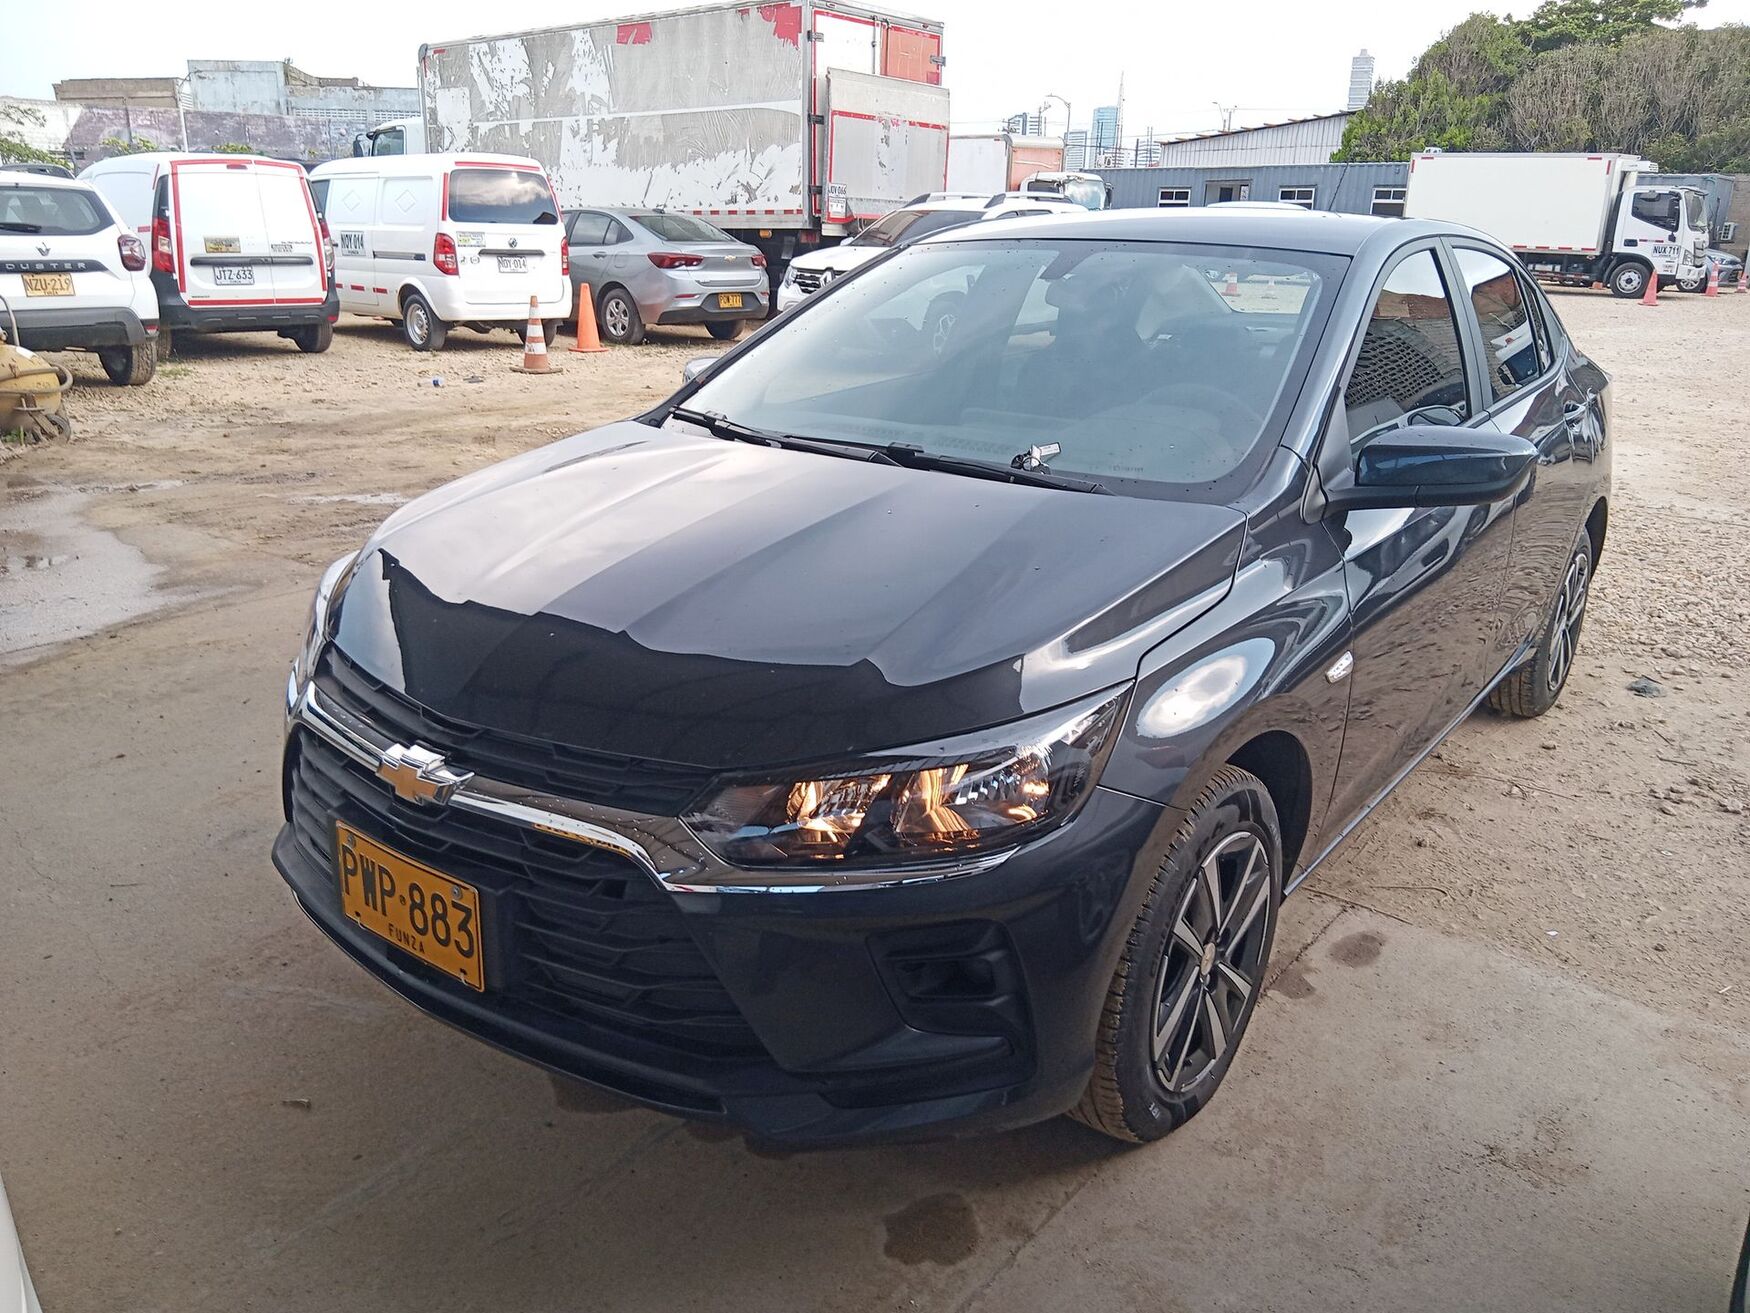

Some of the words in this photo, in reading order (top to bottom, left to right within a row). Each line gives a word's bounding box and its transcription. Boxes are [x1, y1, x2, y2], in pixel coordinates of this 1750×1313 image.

[1653, 246, 1668, 254] NUX
[5, 262, 87, 270] DUSTER
[388, 922, 426, 954] FUNZA
